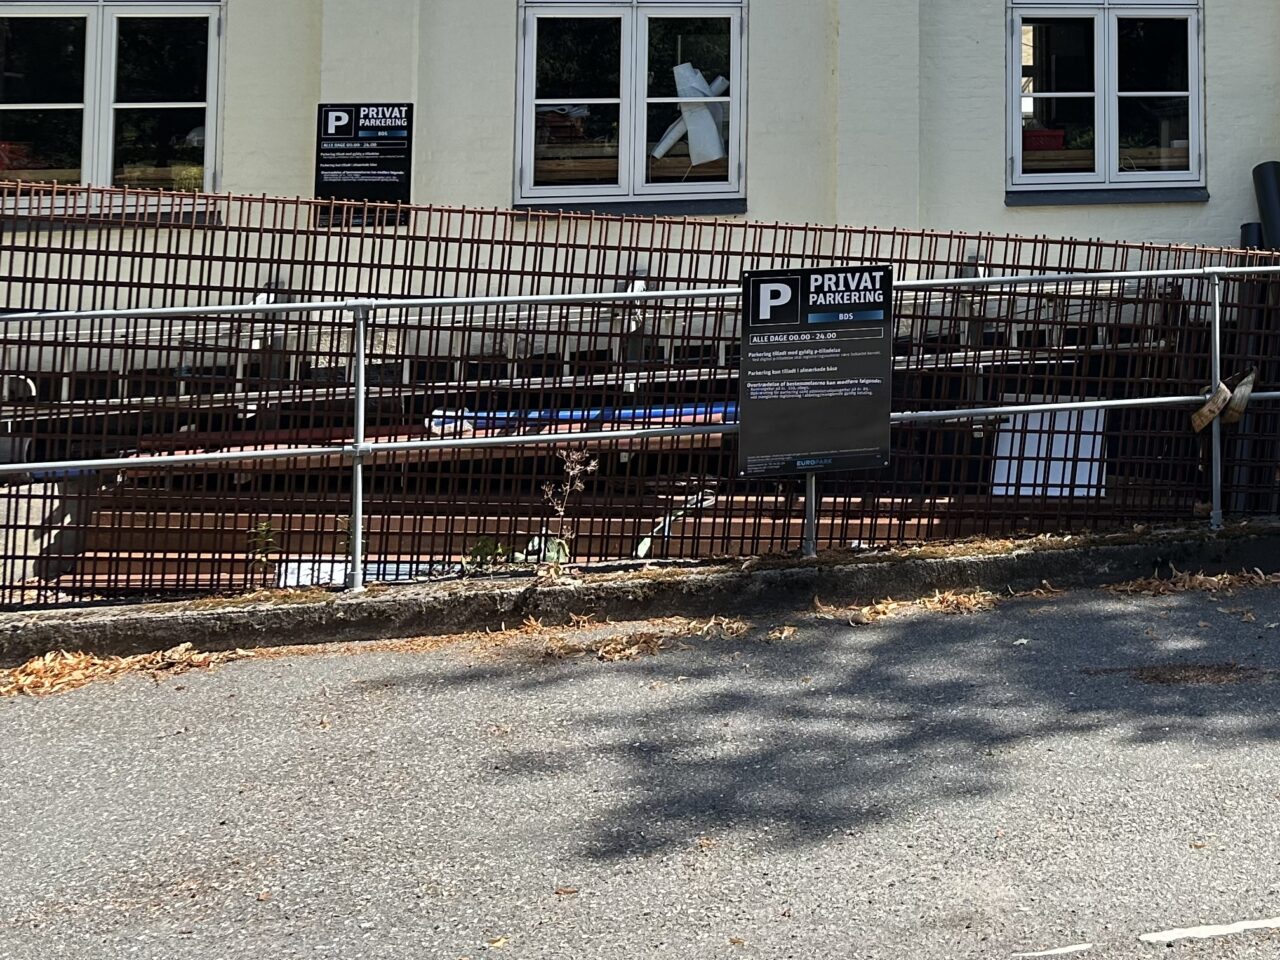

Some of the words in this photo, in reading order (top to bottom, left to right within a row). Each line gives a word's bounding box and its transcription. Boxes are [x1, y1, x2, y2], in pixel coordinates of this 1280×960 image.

[360, 107, 408, 118] PRIVAT
[327, 111, 350, 134] P
[359, 118, 408, 127] PARKERING
[810, 271, 884, 292] PRIVAT
[759, 283, 792, 320] P
[808, 290, 884, 305] PARKERING
[838, 313, 854, 321] BDS
[752, 335, 769, 343] ALLE
[769, 334, 788, 342] DAGE
[796, 458, 833, 466] EUROPARK
